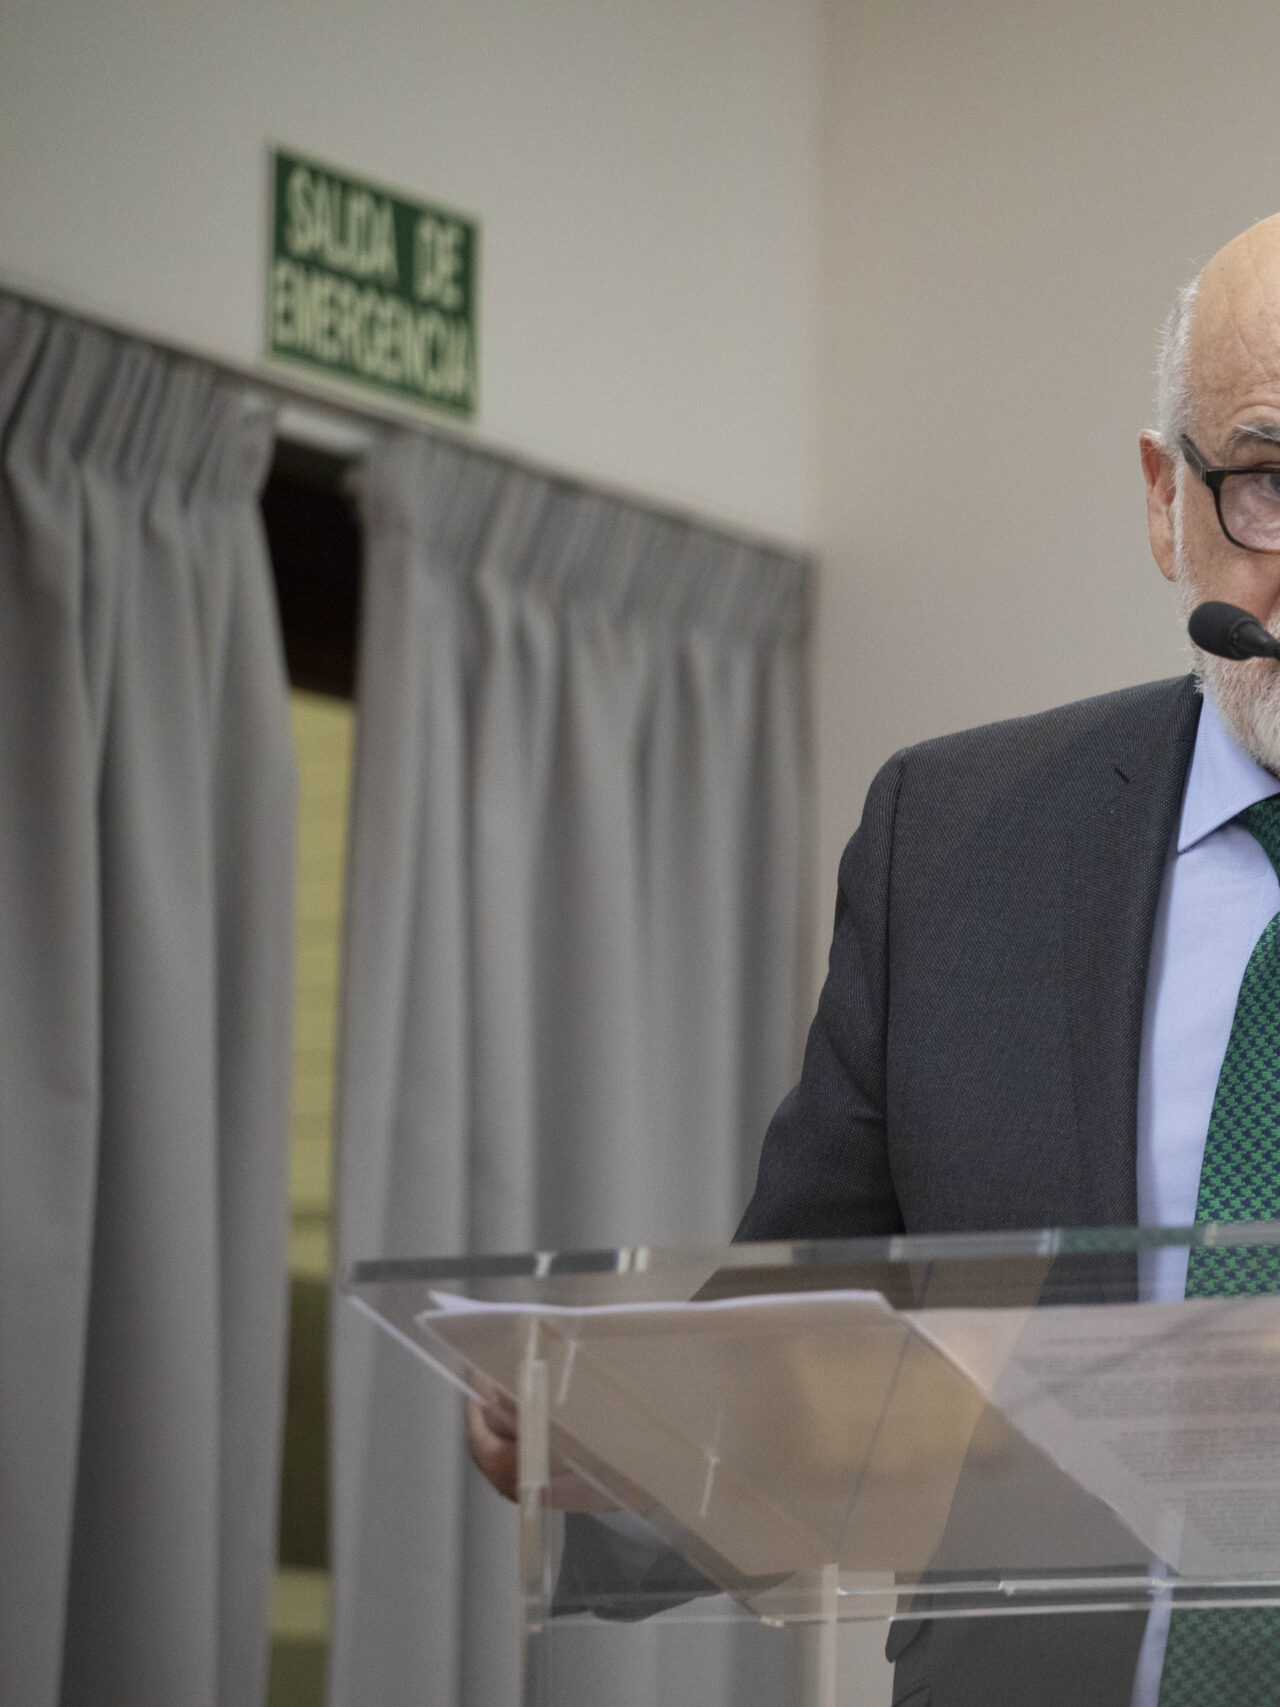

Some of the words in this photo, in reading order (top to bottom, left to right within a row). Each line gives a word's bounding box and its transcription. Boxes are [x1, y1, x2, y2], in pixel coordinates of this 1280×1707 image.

[285, 165, 397, 276] SALIDA
[413, 214, 463, 310] DE
[273, 259, 474, 397] EMERGENCIA
